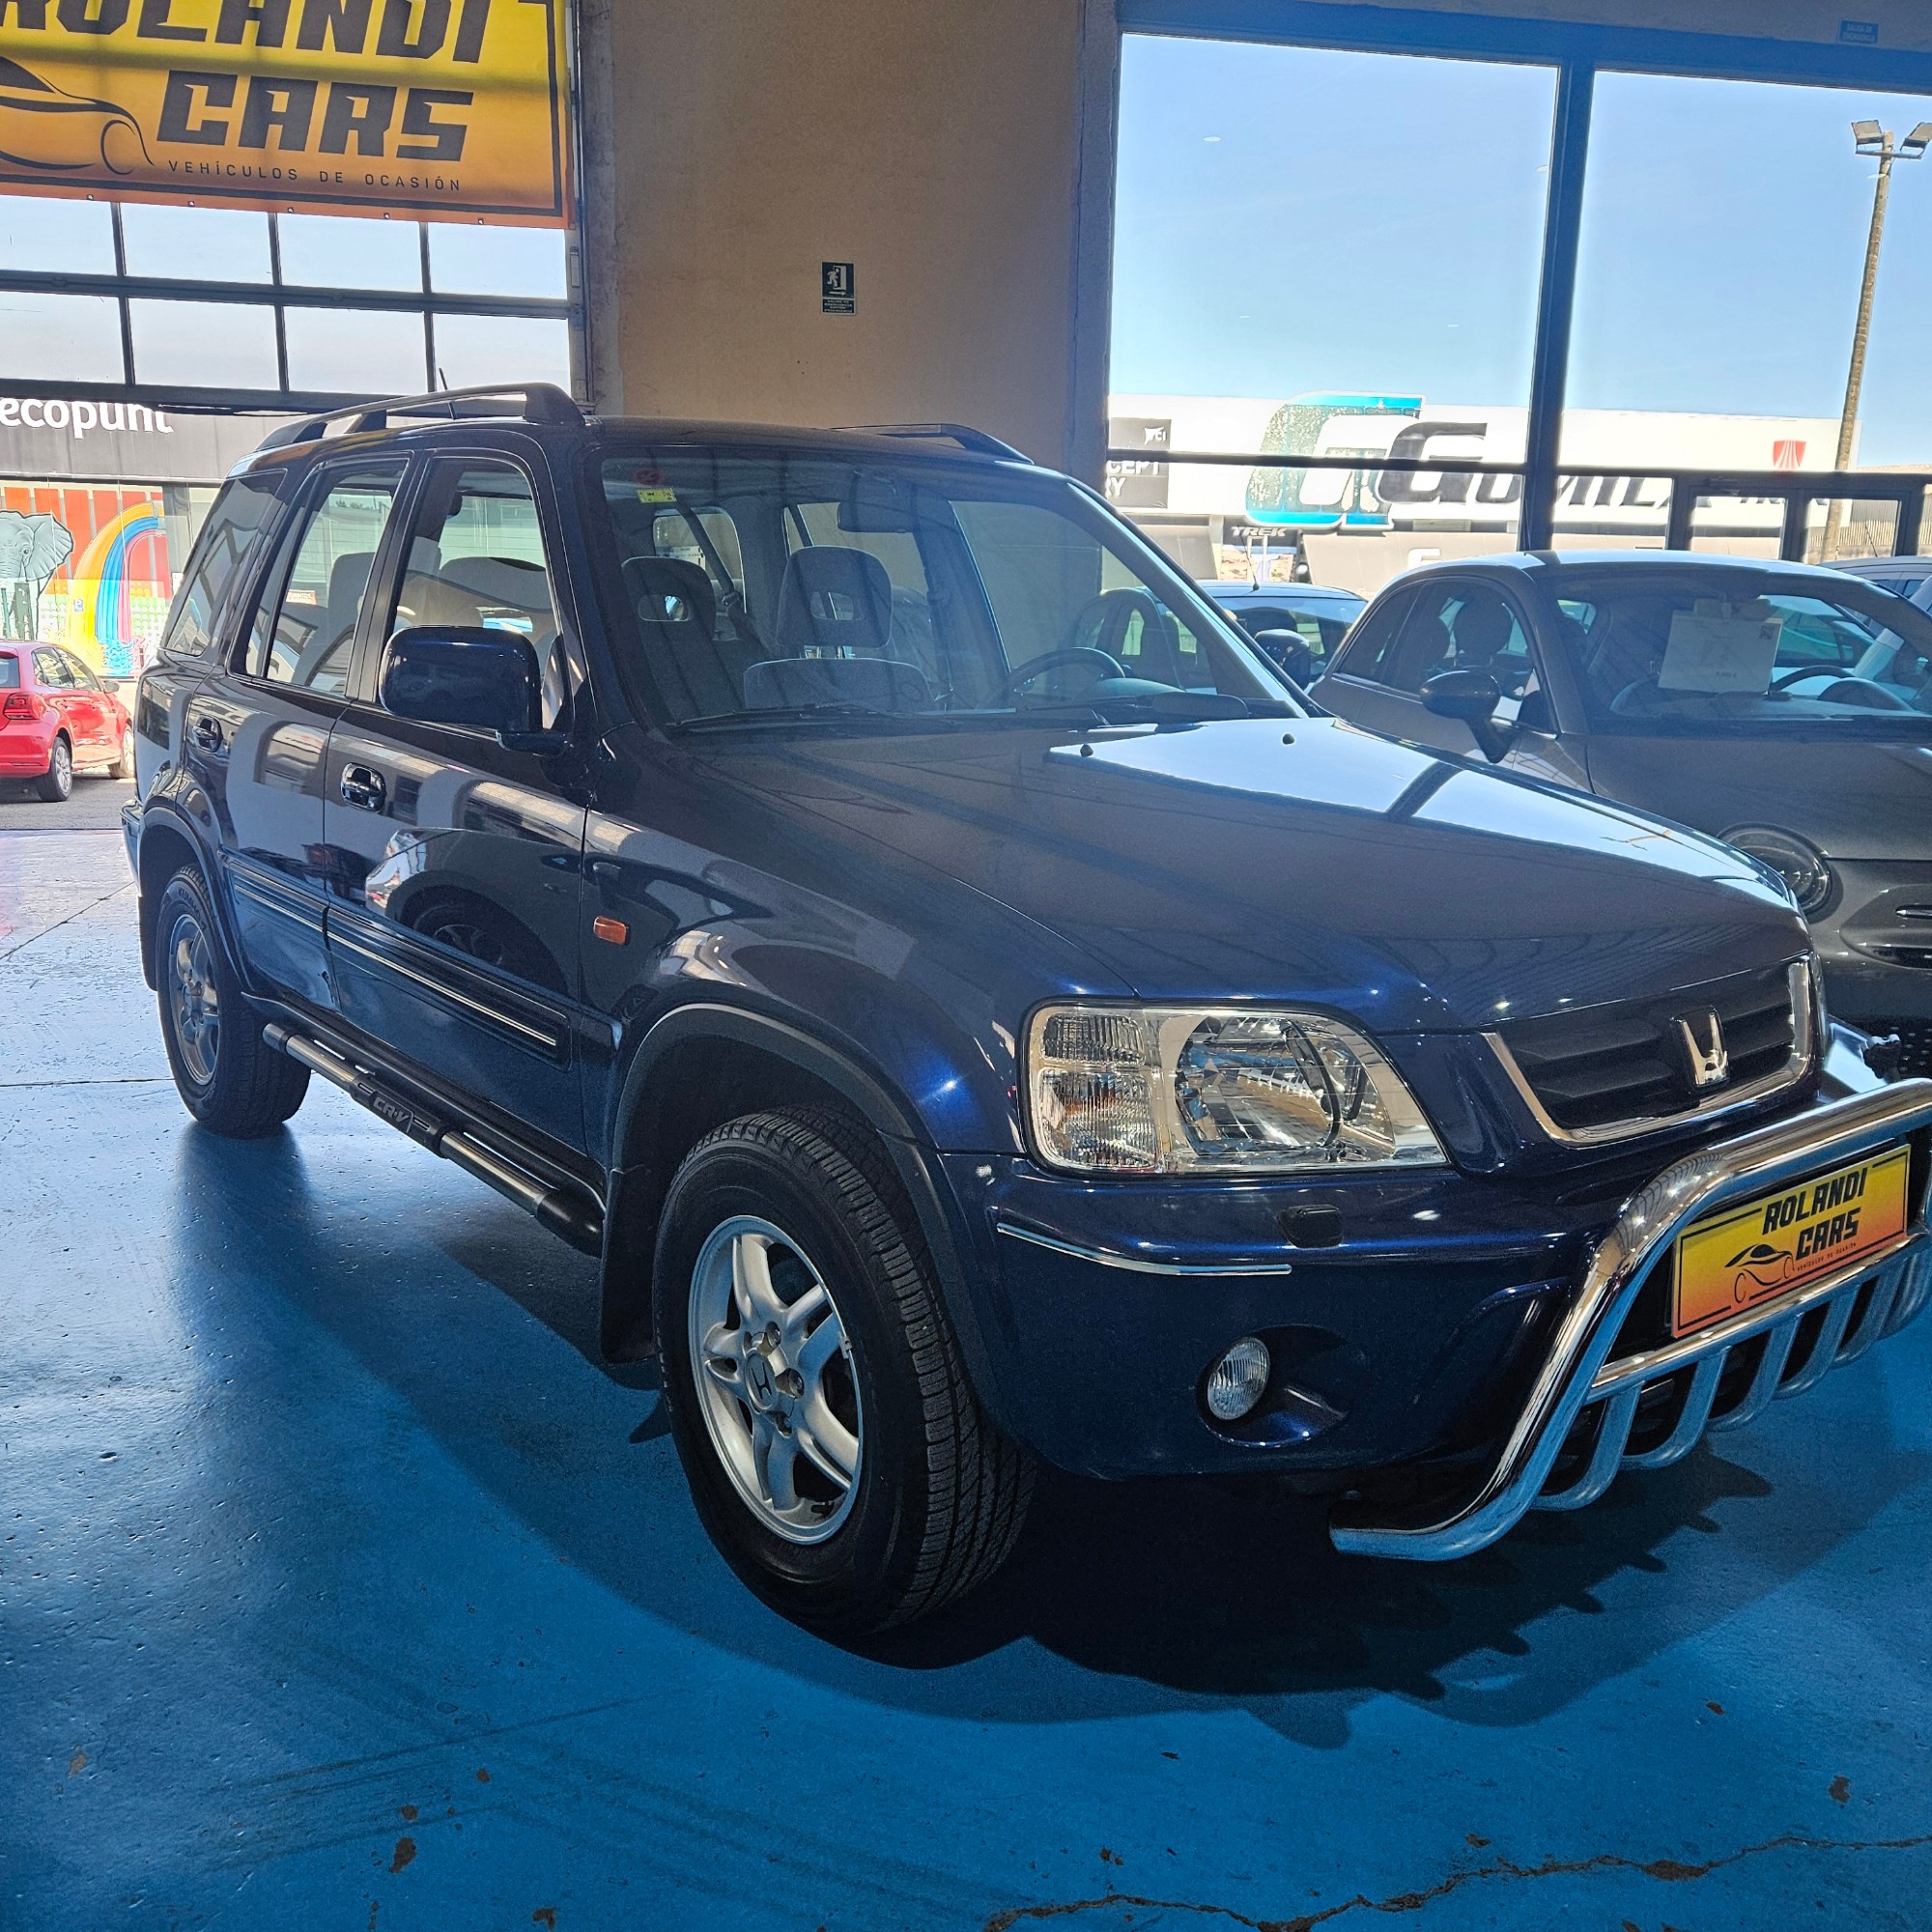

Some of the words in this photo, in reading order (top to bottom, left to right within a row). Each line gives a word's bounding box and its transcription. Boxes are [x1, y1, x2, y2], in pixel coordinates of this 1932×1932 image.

[156, 70, 473, 161] CARS
[168, 160, 298, 181] VEHÍCULOS
[319, 171, 344, 184] DE
[364, 174, 460, 191] OCASIÓN
[1231, 526, 1287, 537] TREK
[1762, 1167, 1868, 1235] ROLANDI
[1796, 1207, 1861, 1260] CARS
